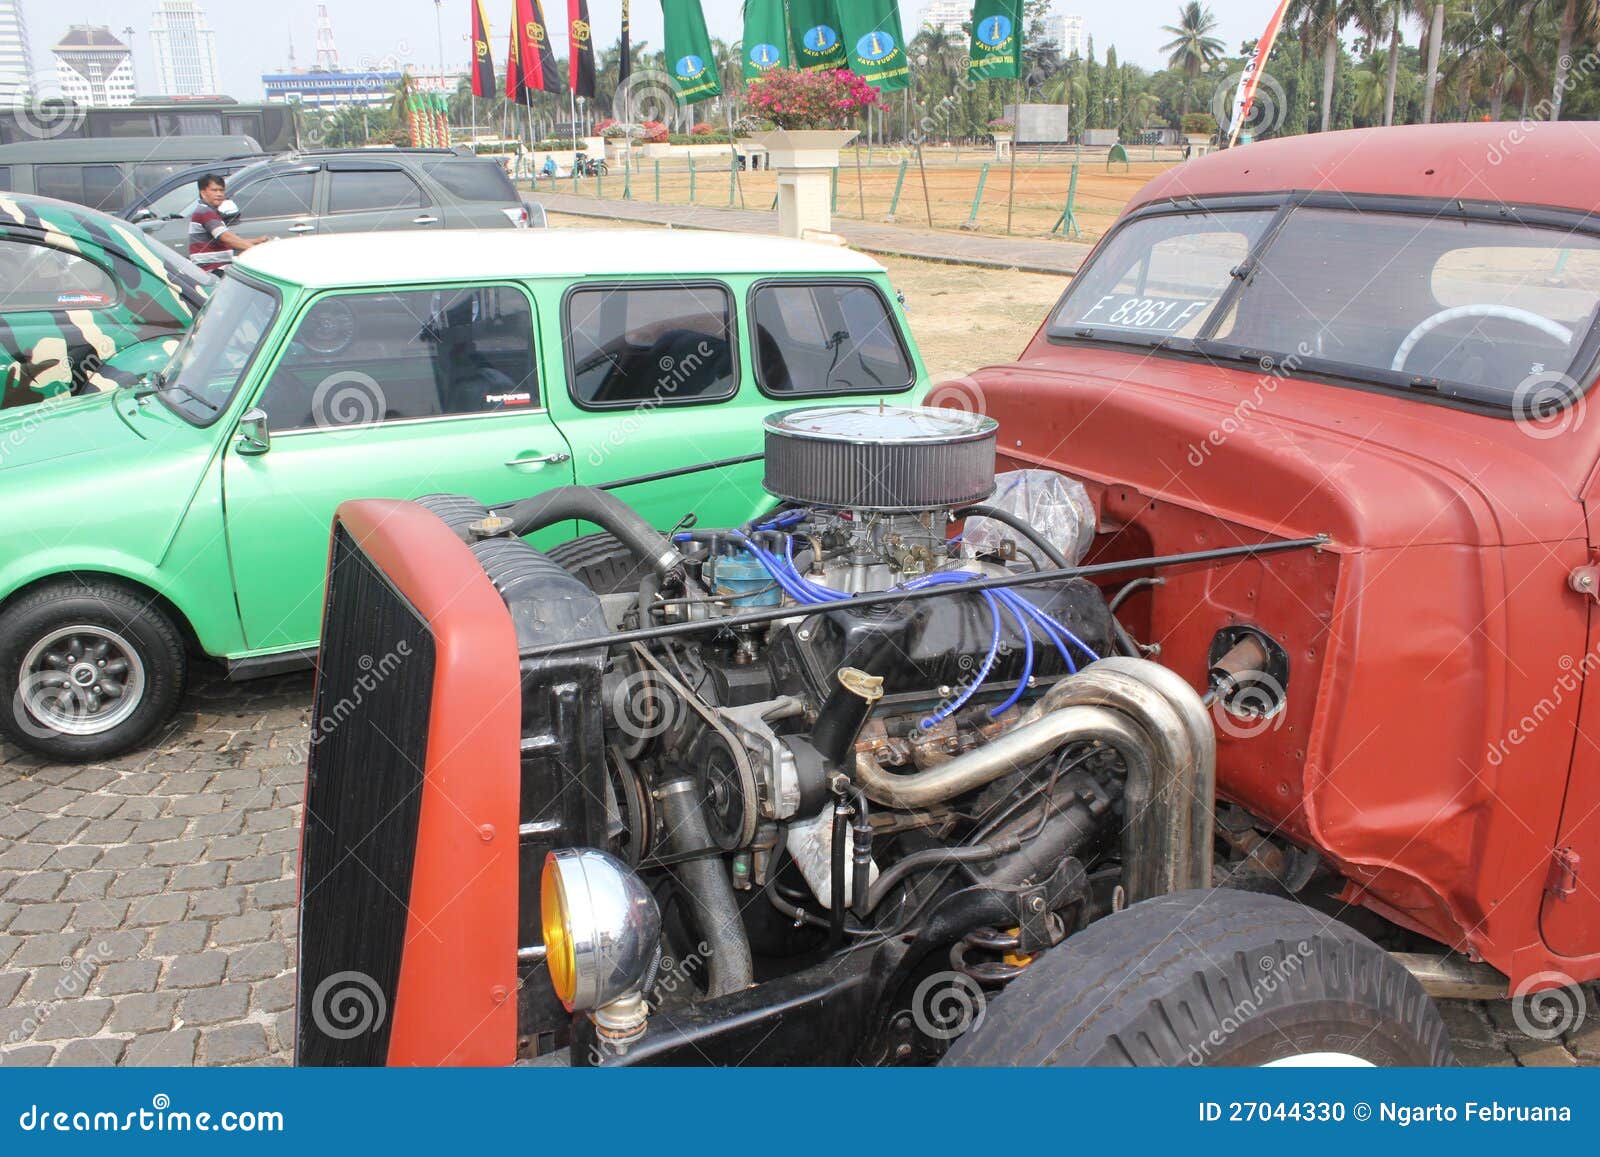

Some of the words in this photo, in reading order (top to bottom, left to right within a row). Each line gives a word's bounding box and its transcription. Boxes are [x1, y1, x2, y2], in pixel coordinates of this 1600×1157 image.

[1082, 295, 1114, 320] F
[1109, 298, 1178, 327] 8361
[1167, 301, 1207, 328] F
